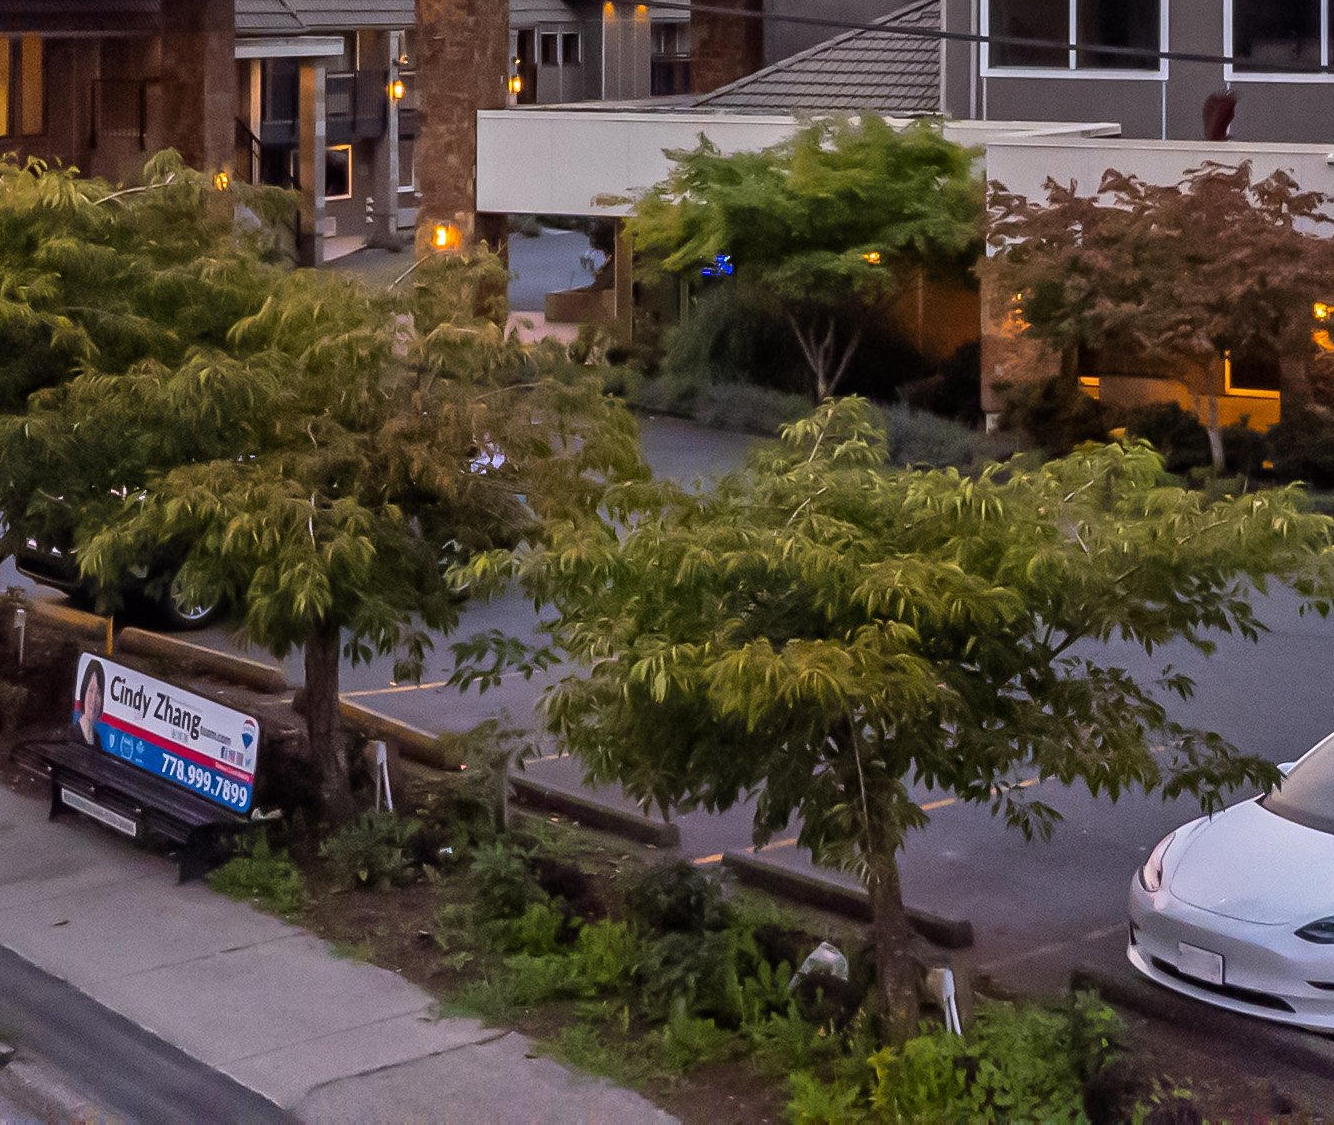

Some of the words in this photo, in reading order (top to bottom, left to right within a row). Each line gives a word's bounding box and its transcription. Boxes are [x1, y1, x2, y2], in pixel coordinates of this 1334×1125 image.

[110, 675, 152, 719] Cindy
[153, 692, 202, 741] Zhang
[161, 752, 247, 808] 778.999.7899
